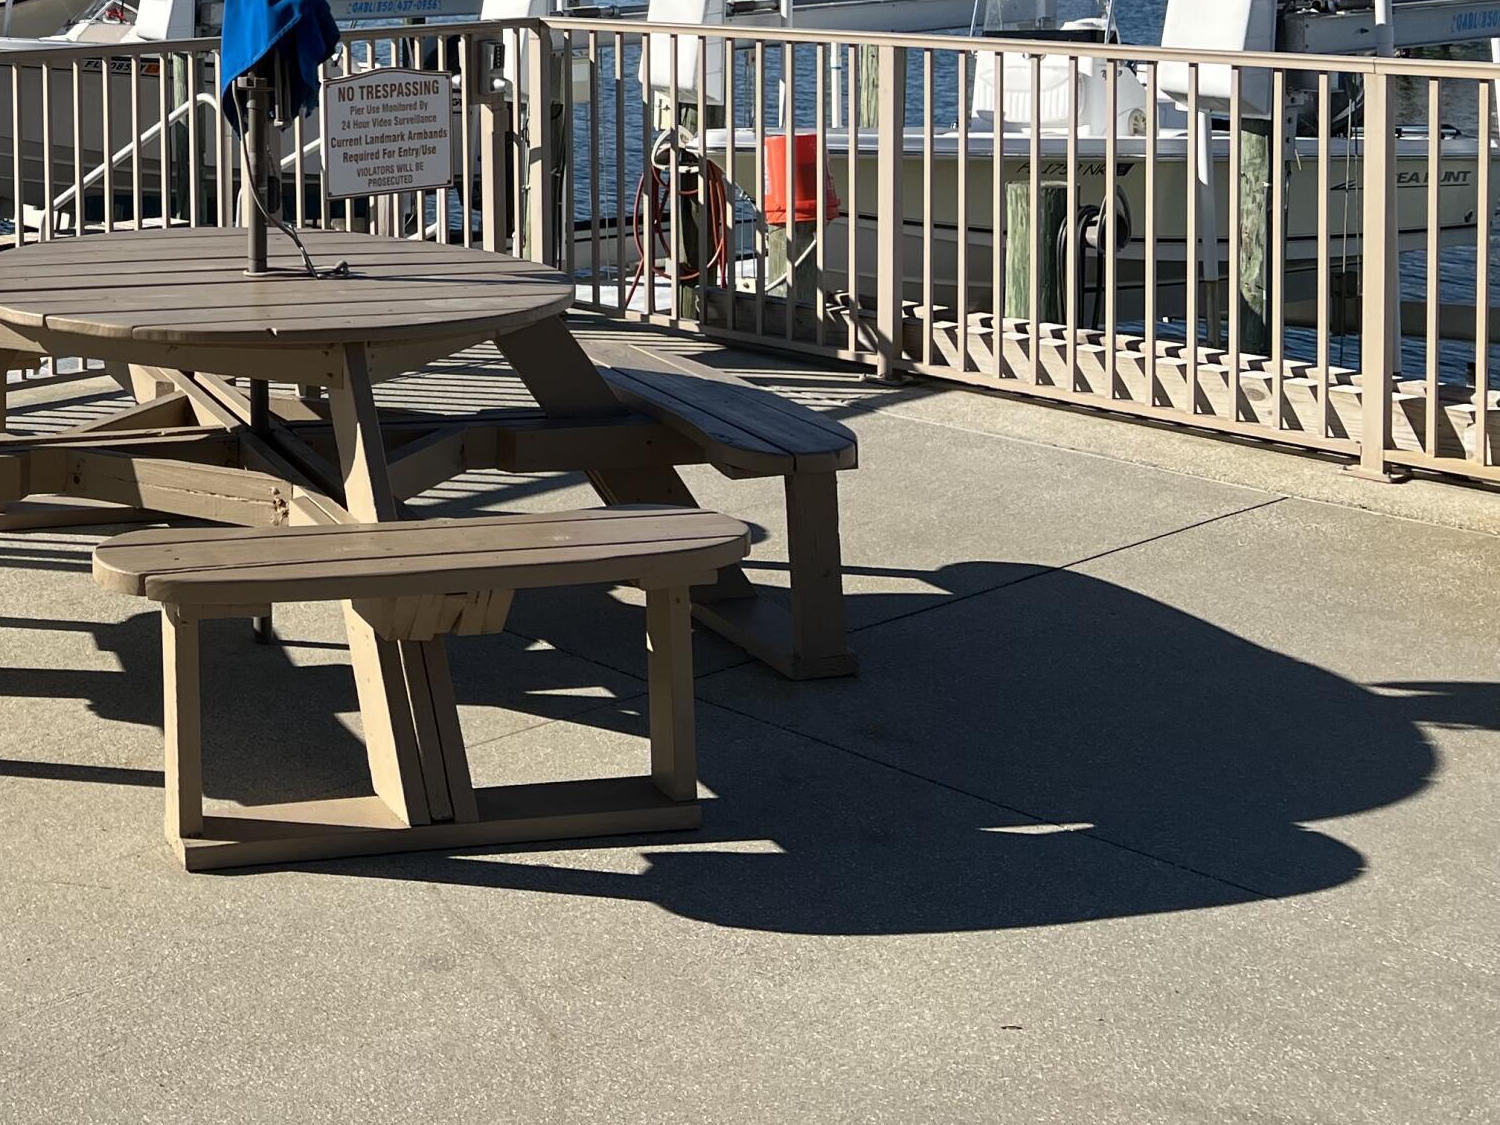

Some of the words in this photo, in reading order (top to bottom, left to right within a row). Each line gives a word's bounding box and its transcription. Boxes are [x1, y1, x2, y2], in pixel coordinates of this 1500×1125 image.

[338, 86, 355, 102] NO
[359, 79, 440, 101] TRESPASSING
[350, 105, 364, 116] Pier
[367, 104, 380, 115] Use
[382, 101, 417, 114] Monitored
[419, 100, 428, 112] By
[341, 120, 350, 130] 24
[353, 119, 370, 130] Hour
[372, 117, 392, 128] Video
[394, 114, 437, 127] Surveillance
[330, 136, 362, 149] Current
[365, 132, 405, 146] Landmark
[407, 127, 448, 142] Armbands
[343, 149, 380, 164] Required
[382, 148, 396, 159] For
[356, 164, 395, 177] VIOLATORS
[396, 163, 414, 173] WILL
[415, 161, 424, 172] BE
[368, 174, 413, 188] PROSECUTED
[1423, 171, 1471, 184] UNT
